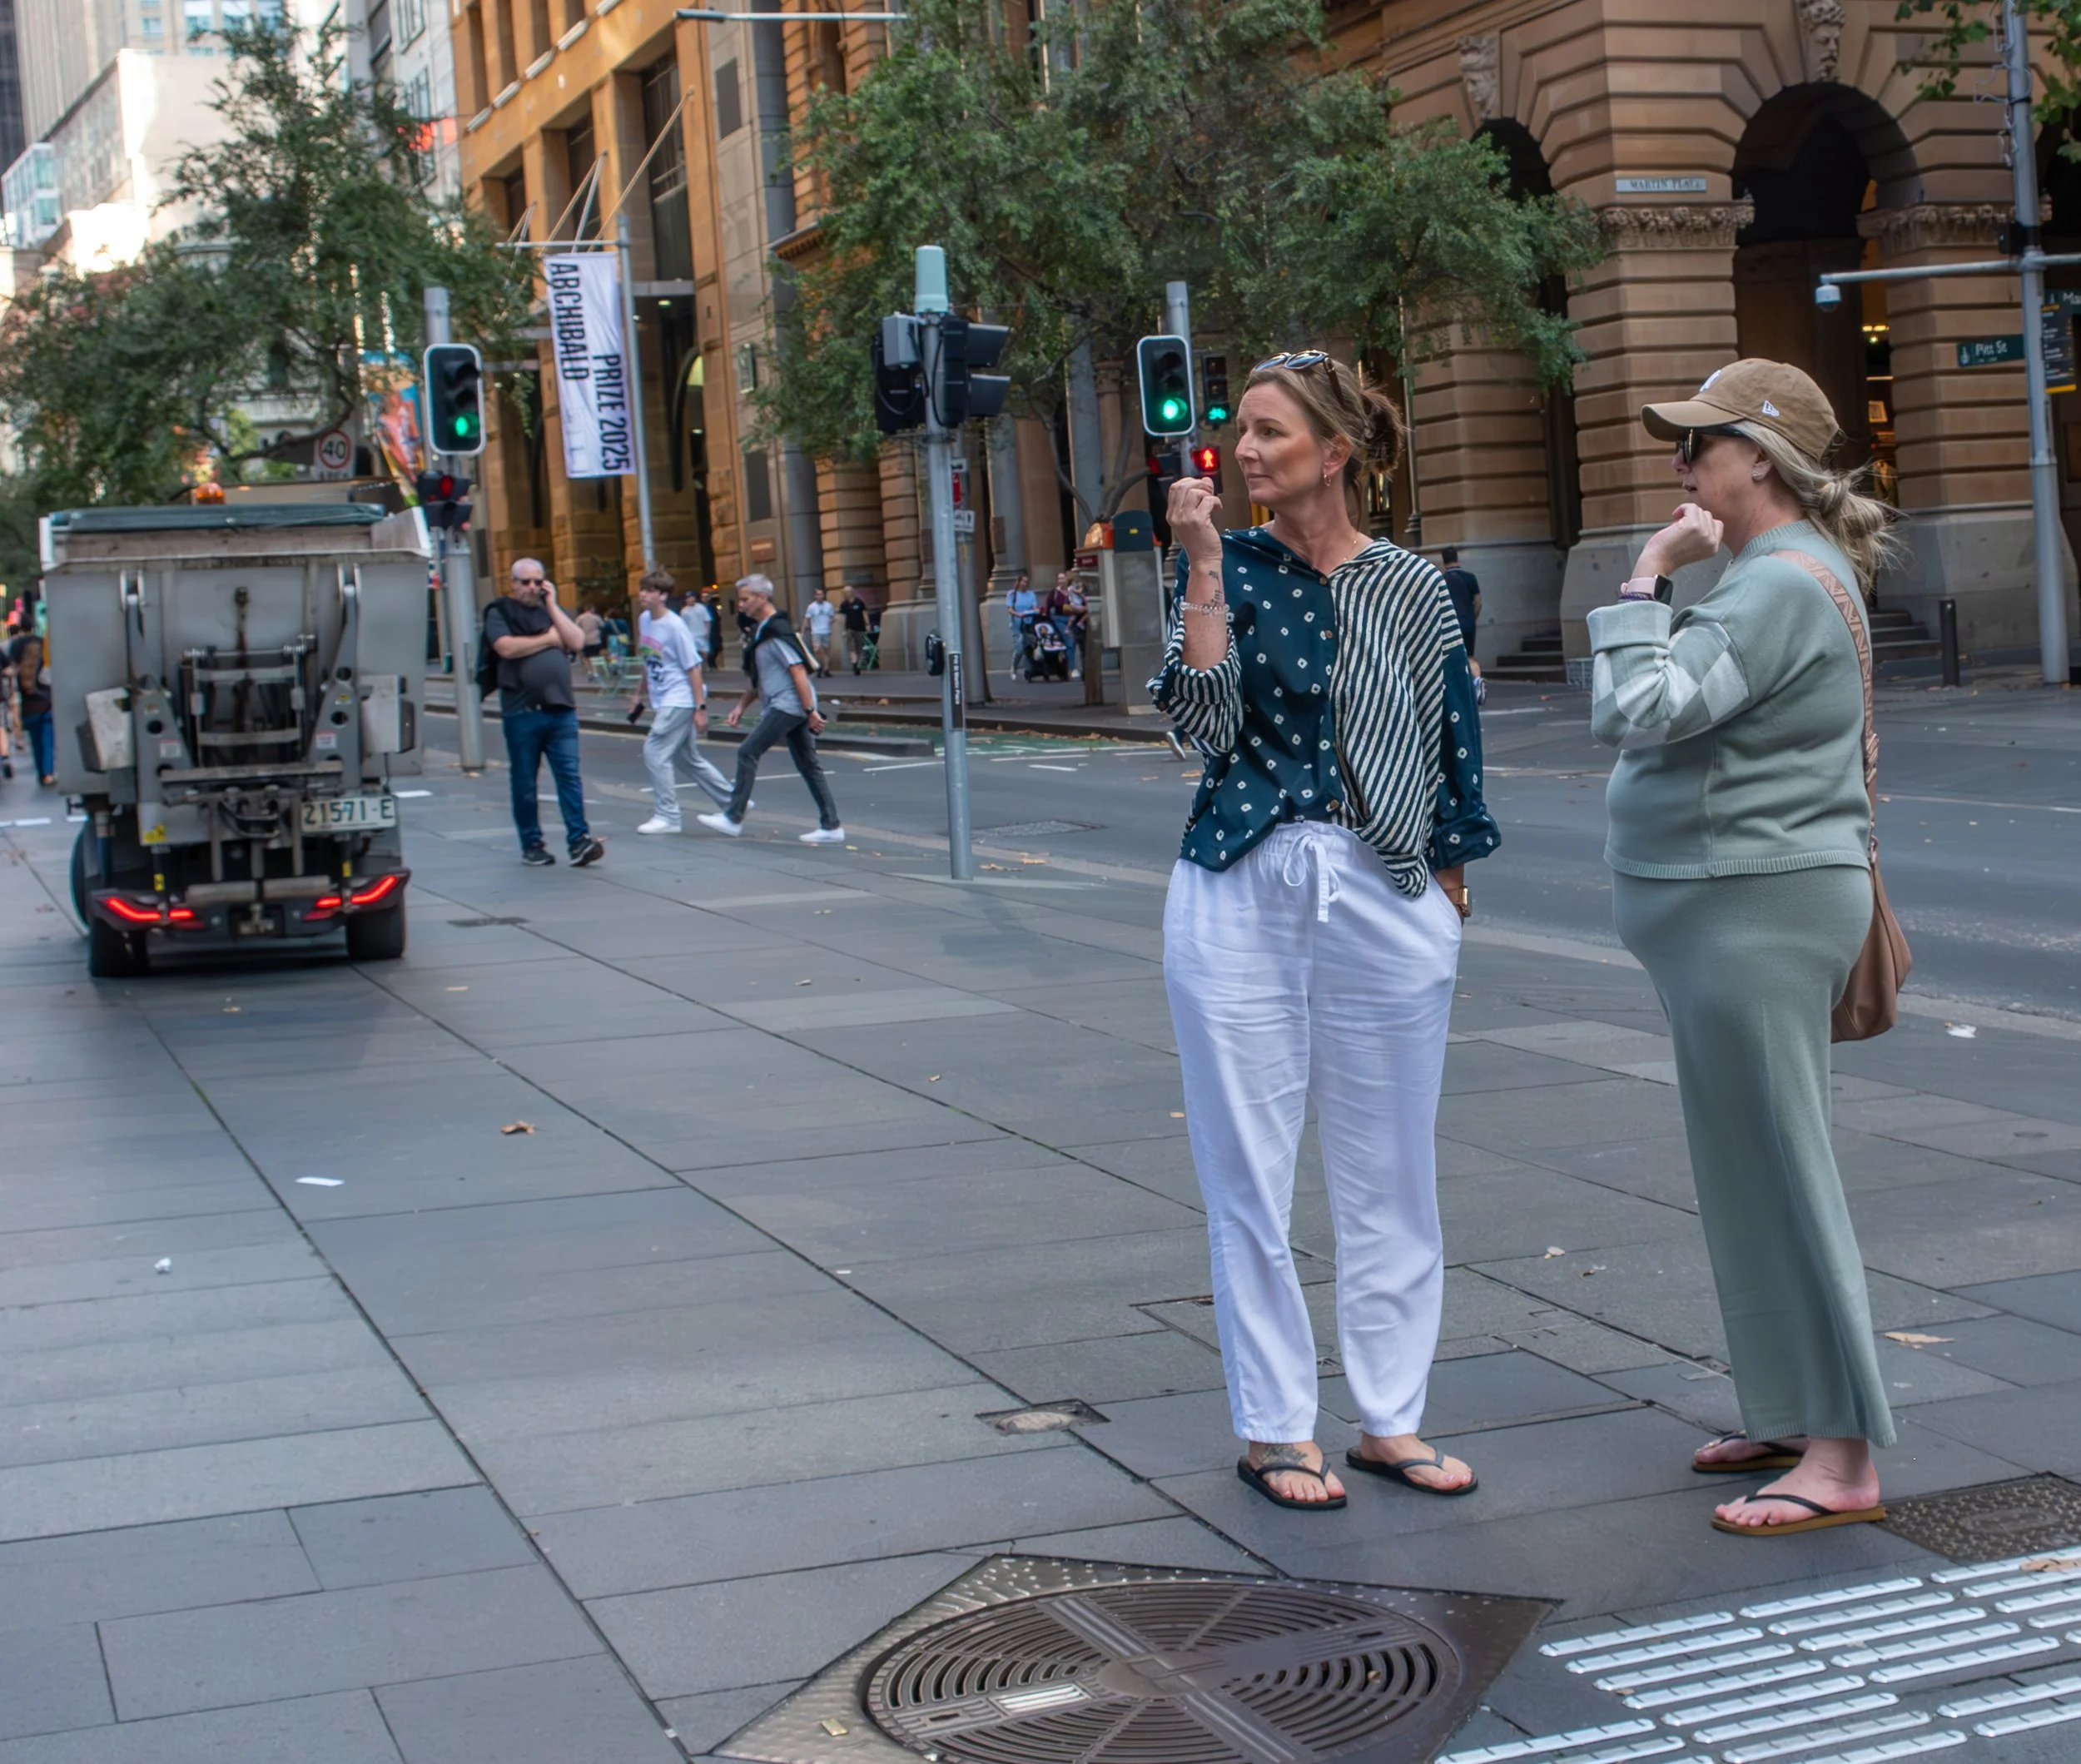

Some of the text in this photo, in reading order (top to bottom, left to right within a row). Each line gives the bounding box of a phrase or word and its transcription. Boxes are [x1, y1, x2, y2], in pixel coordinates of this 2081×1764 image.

[1630, 177, 1668, 190] MARTIN
[549, 262, 589, 381] ARCHIBALD
[592, 353, 631, 472] PRIZE 2025
[323, 440, 346, 460] 40
